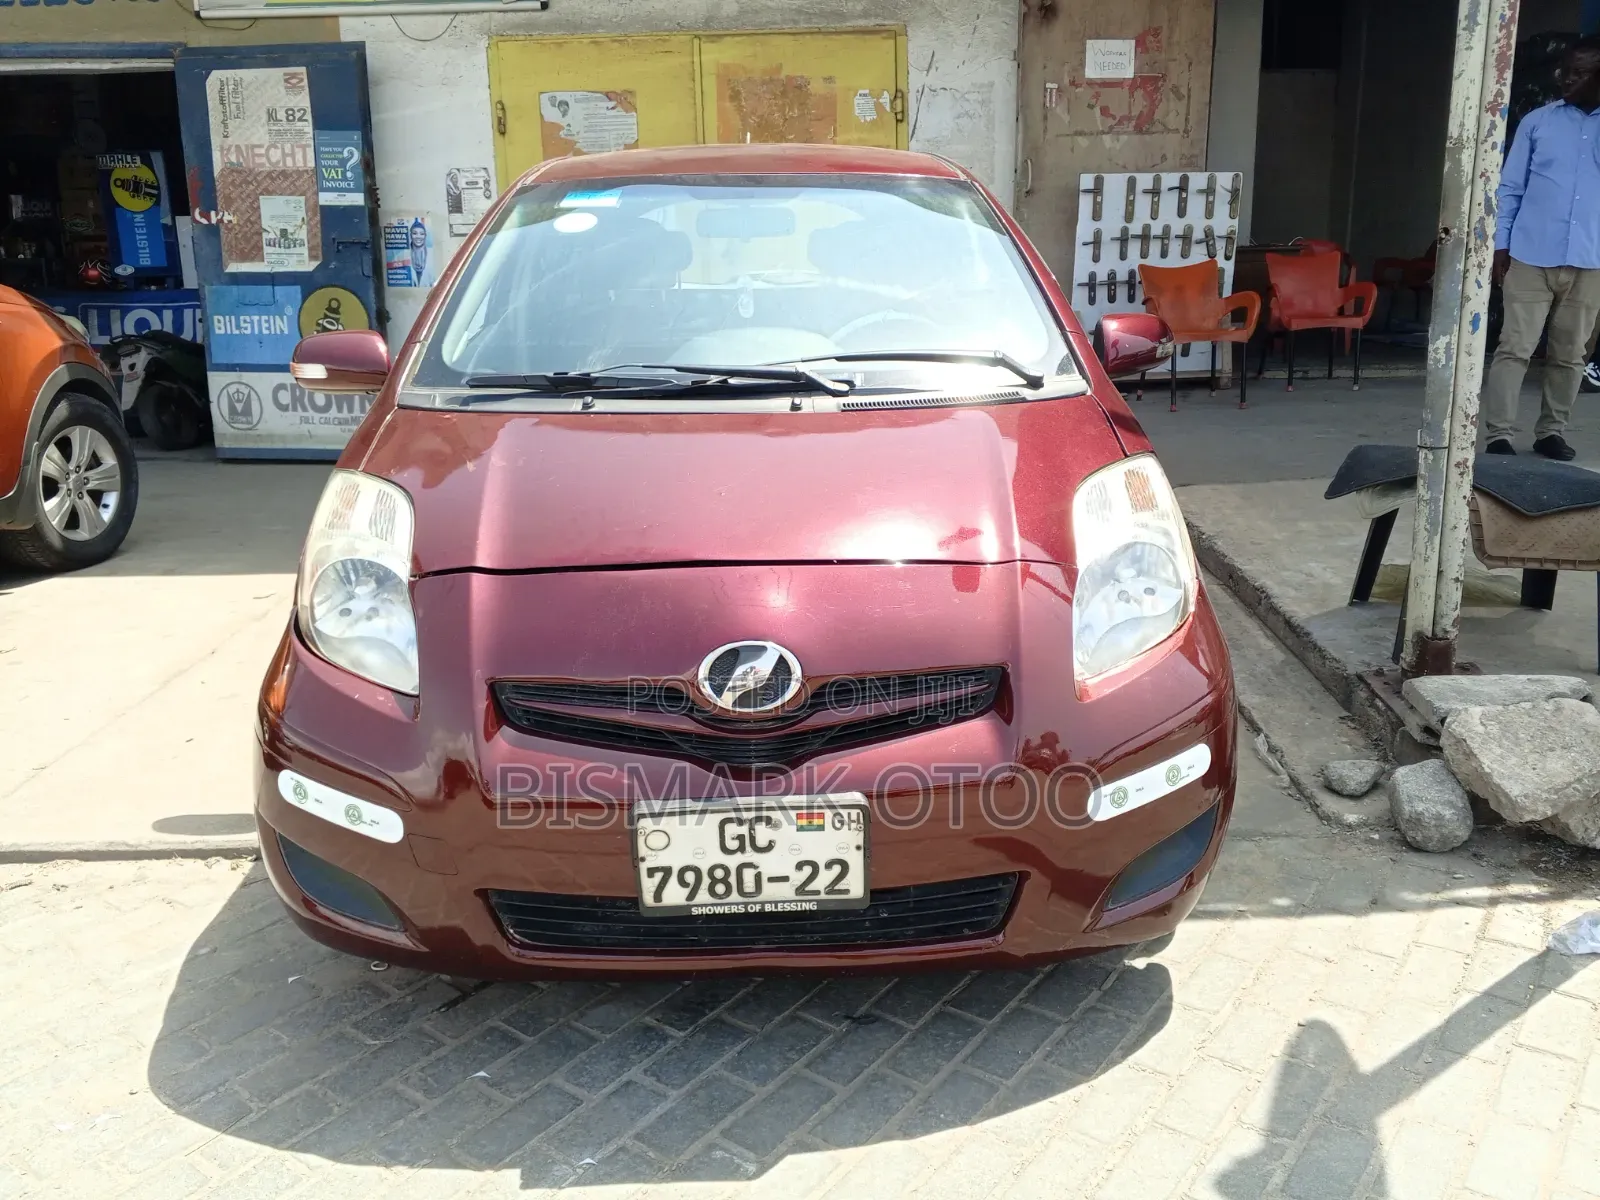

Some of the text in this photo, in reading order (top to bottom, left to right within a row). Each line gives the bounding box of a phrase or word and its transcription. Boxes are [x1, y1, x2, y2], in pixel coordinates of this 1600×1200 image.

[1094, 60, 1126, 71] NEEDED
[231, 76, 242, 120] Fuel filter
[267, 107, 309, 123] KL 82
[98, 154, 138, 164] MAHLE
[219, 143, 312, 168] KNECHT
[322, 168, 344, 178] VAT
[132, 213, 152, 266] BILSTEIN
[213, 315, 289, 335] BILSTEIN
[300, 415, 316, 425] FULL
[718, 811, 864, 855] GC GH
[646, 858, 851, 903] 7980-22
[691, 901, 818, 915] SHOWERS OF BLESSING
